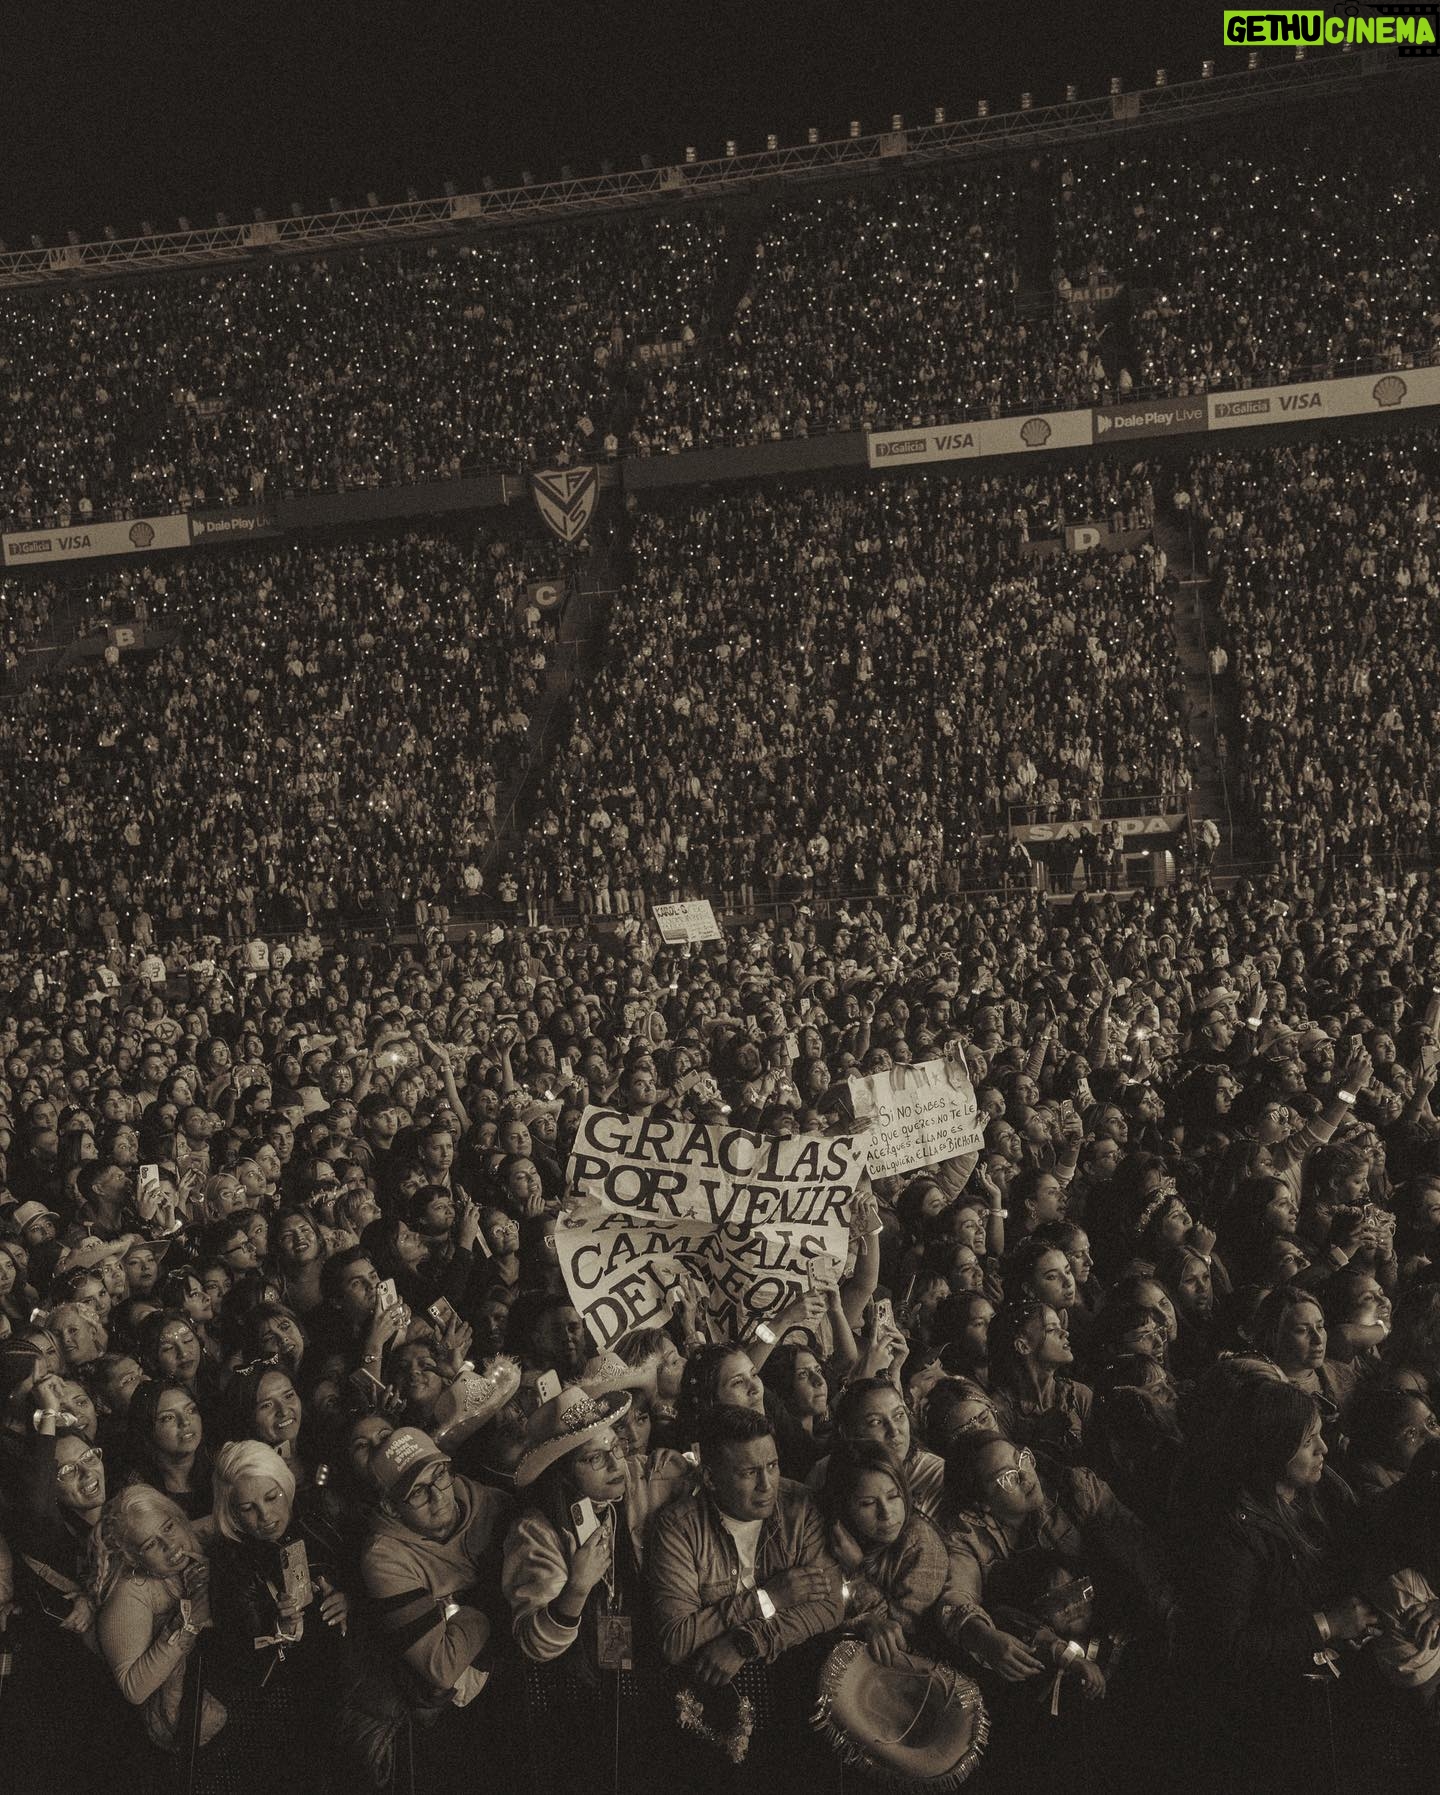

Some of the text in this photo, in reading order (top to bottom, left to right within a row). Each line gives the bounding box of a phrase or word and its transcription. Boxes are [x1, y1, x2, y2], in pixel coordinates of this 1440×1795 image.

[1232, 401, 1268, 415] Galicia
[1279, 392, 1322, 411] VISA
[1175, 408, 1202, 422] Live
[891, 441, 926, 454] Galicia
[933, 433, 974, 451] VISA
[57, 535, 91, 550] VISA
[1074, 528, 1100, 551] D
[536, 586, 557, 606] C
[115, 628, 136, 646] B
[1029, 818, 1172, 841] SALDA
[897, 1105, 912, 1120] NO
[915, 1097, 946, 1115] SABES
[937, 1114, 949, 1124] NO
[950, 1109, 962, 1120] TE
[963, 1104, 976, 1116] LE
[936, 1130, 948, 1140] NO
[950, 1125, 964, 1134] ES
[584, 1111, 855, 1183] GRACIAS
[916, 1146, 939, 1160] ELLA
[570, 1152, 854, 1229] POR VENIR
